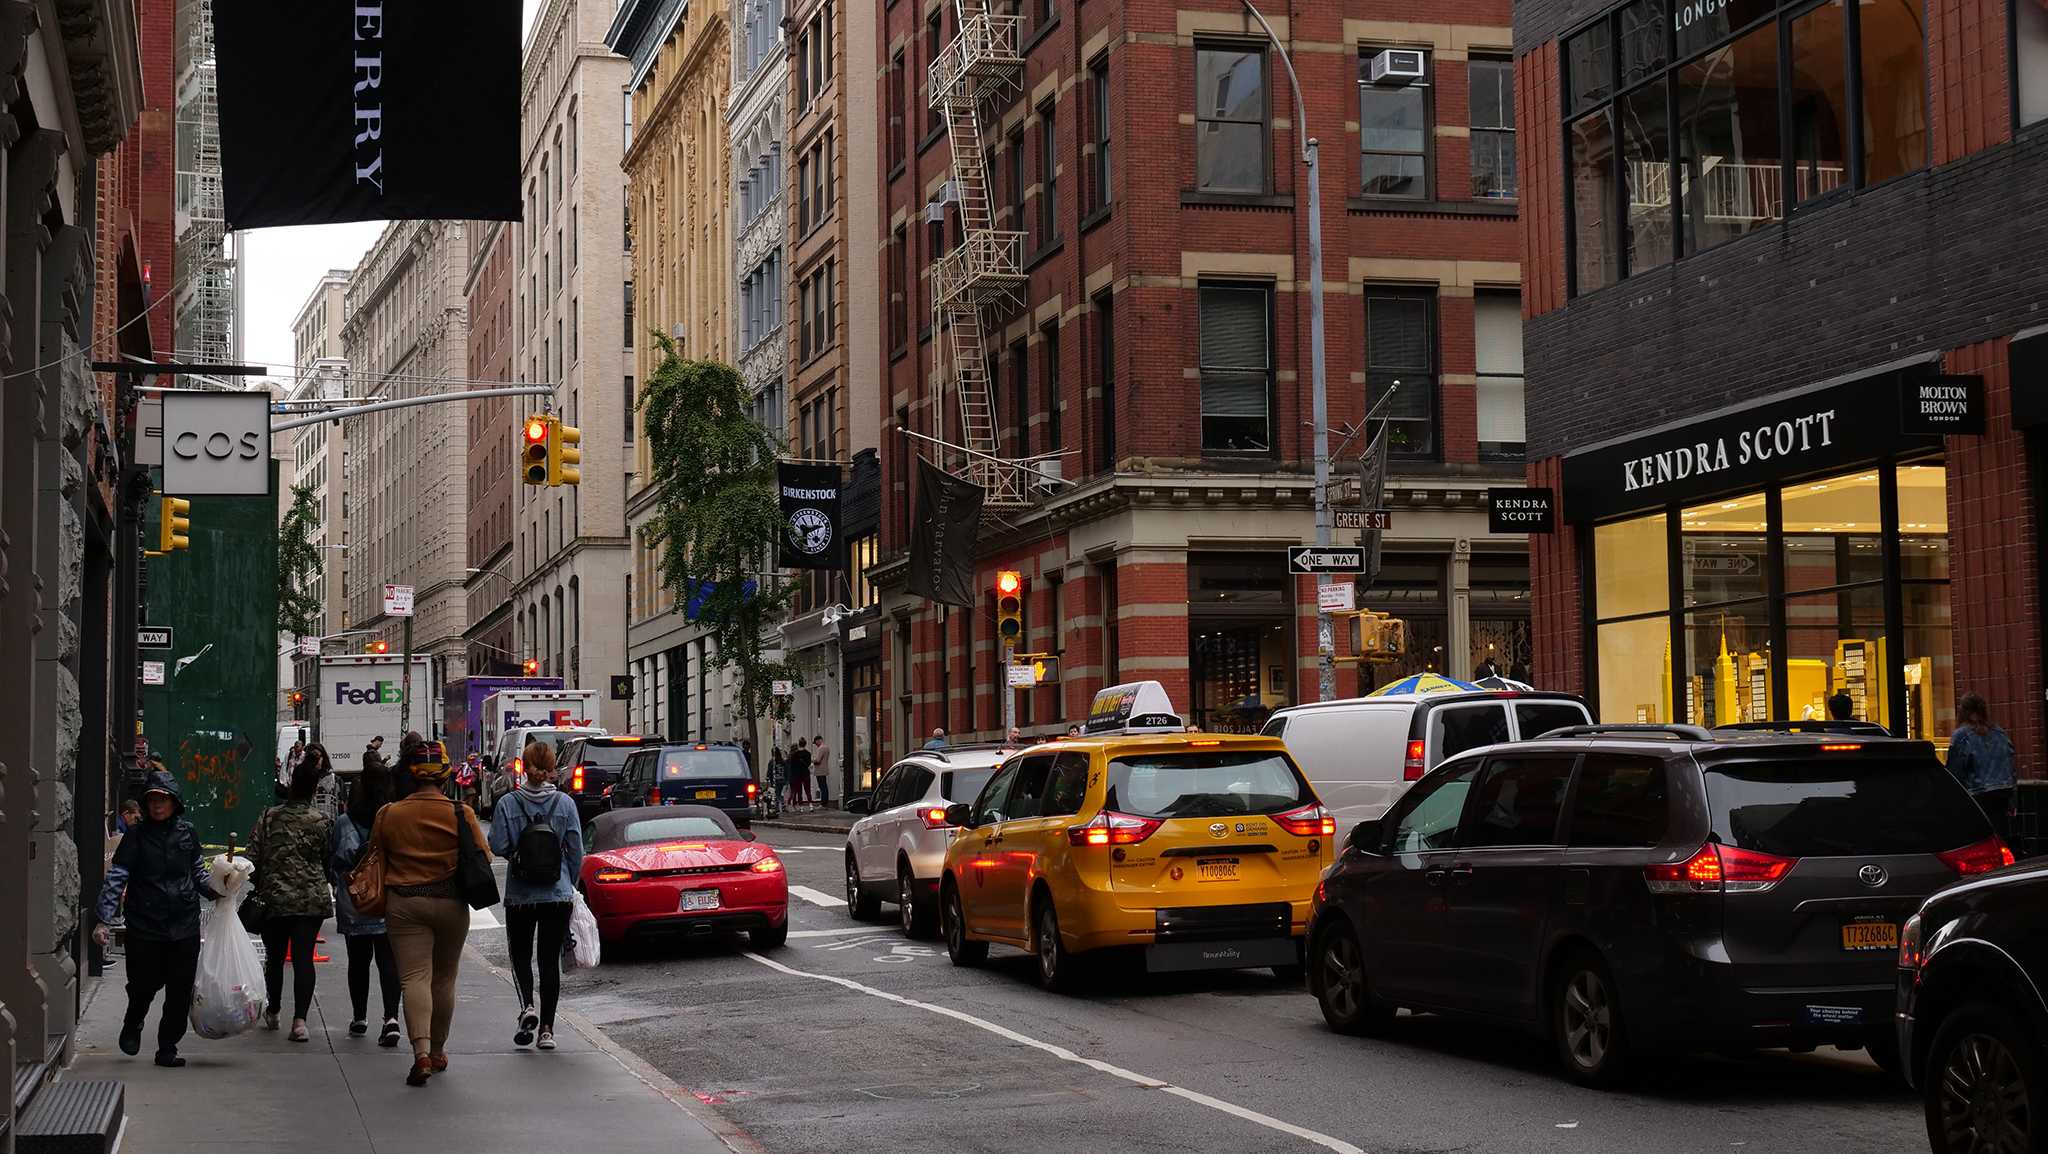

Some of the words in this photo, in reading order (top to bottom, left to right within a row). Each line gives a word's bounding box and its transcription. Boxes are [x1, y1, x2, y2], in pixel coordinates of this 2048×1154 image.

[354, 0, 383, 195] ERRY
[1920, 386, 1967, 399] MOLTON
[1920, 401, 1967, 413] BROWN
[173, 431, 259, 460] COS
[1624, 438, 1730, 491] KENDRA
[1738, 409, 1835, 465] SCOTT
[783, 486, 836, 499] BIRKENSTOCK
[1496, 500, 1548, 508] KENDRA
[1336, 512, 1370, 528] GREENE
[1375, 513, 1385, 528] ST
[1501, 512, 1543, 520] SCOTT
[1301, 555, 1322, 565] ONE
[1333, 555, 1354, 565] WAY
[1145, 717, 1167, 725] 2T26
[1201, 864, 1237, 877] Y100806C
[1846, 926, 1894, 943] T732686C
